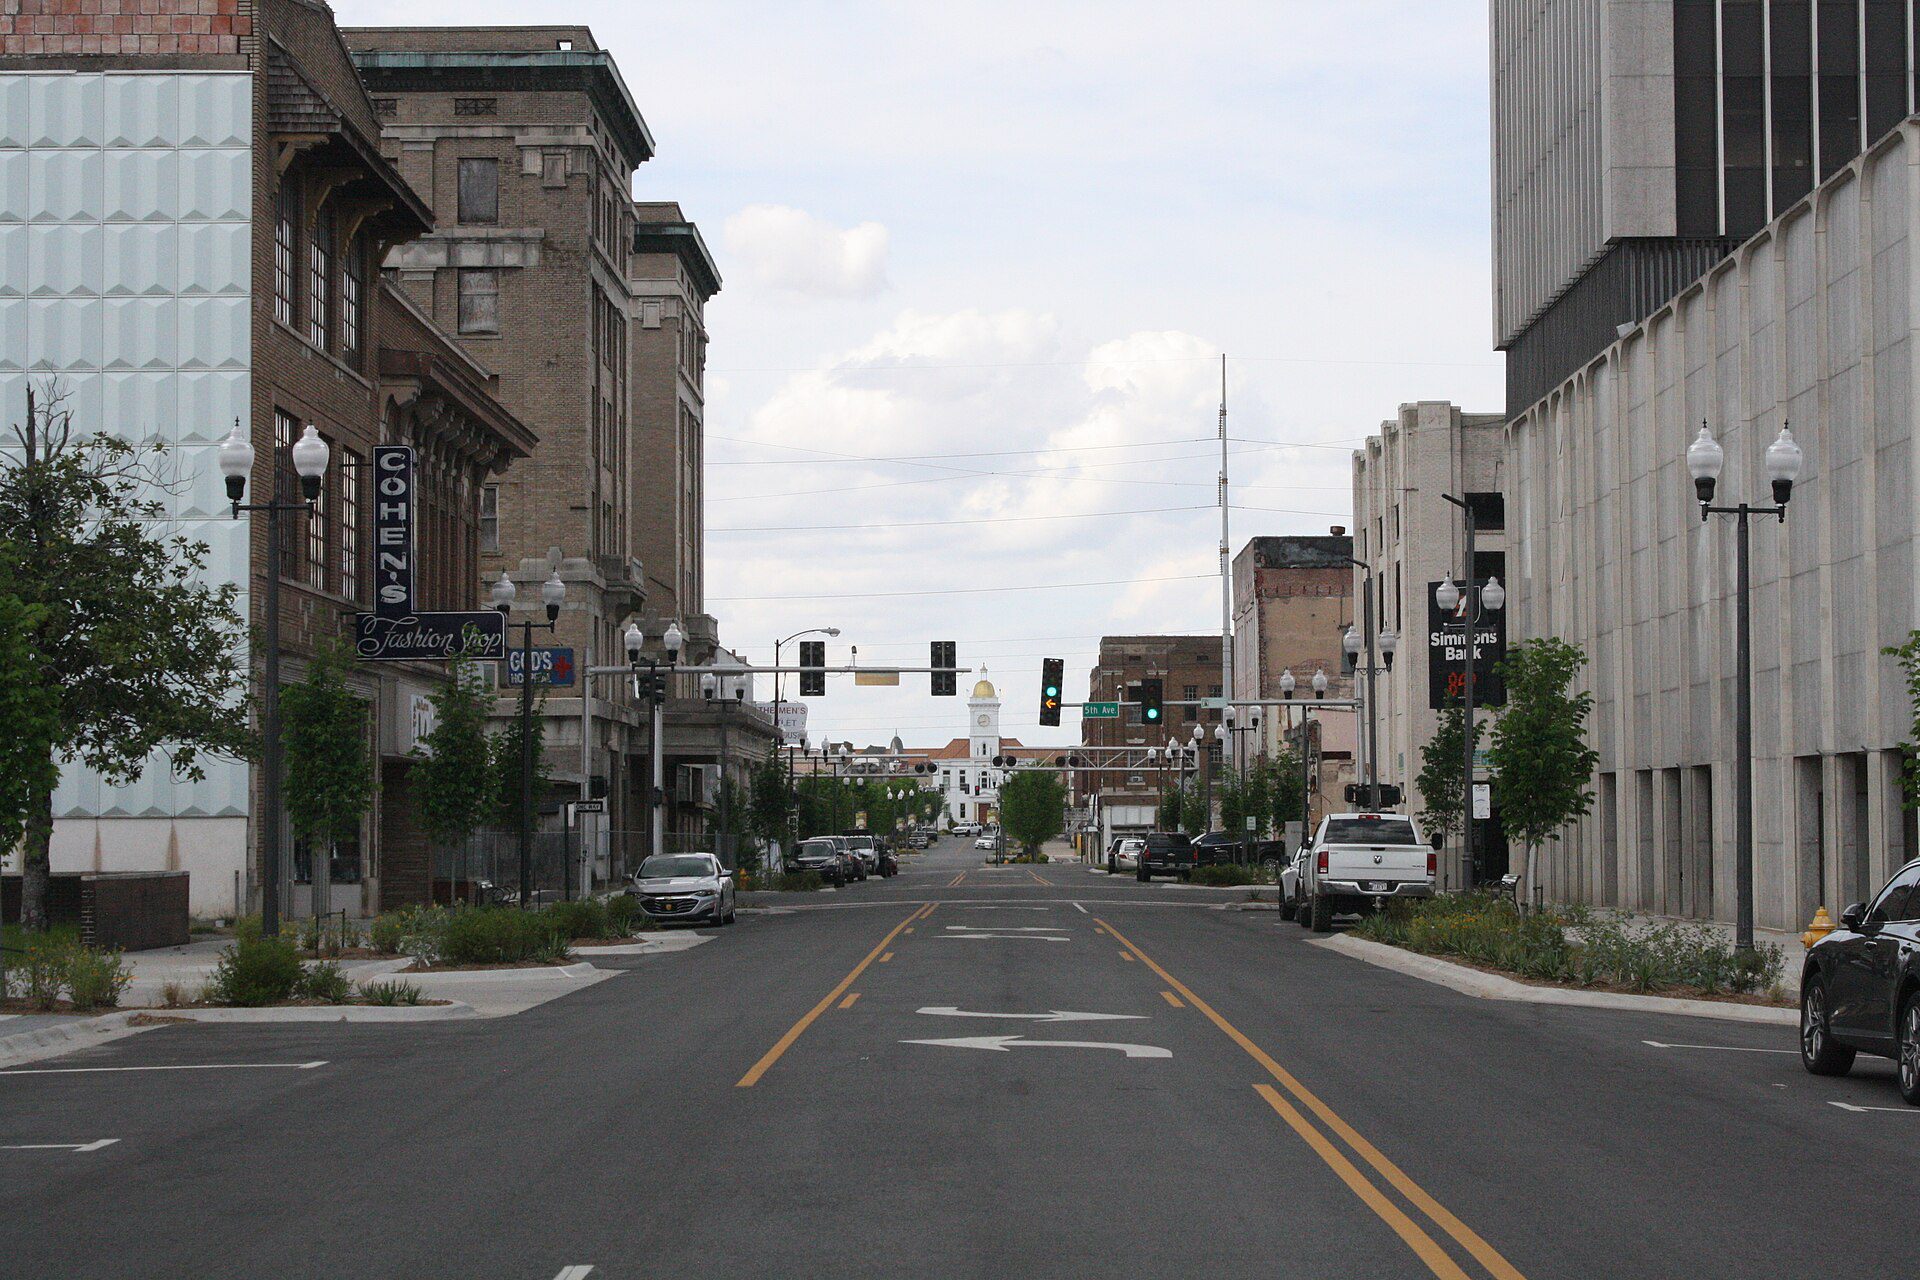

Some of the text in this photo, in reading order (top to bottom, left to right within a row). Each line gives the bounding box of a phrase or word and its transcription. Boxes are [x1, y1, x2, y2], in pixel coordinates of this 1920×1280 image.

[379, 452, 408, 605] COHEN'S
[356, 615, 455, 656] Fashion
[1445, 645, 1482, 661] Bak
[758, 706, 806, 715] THE MEN'S
[1084, 706, 1117, 714] 5th Ave.
